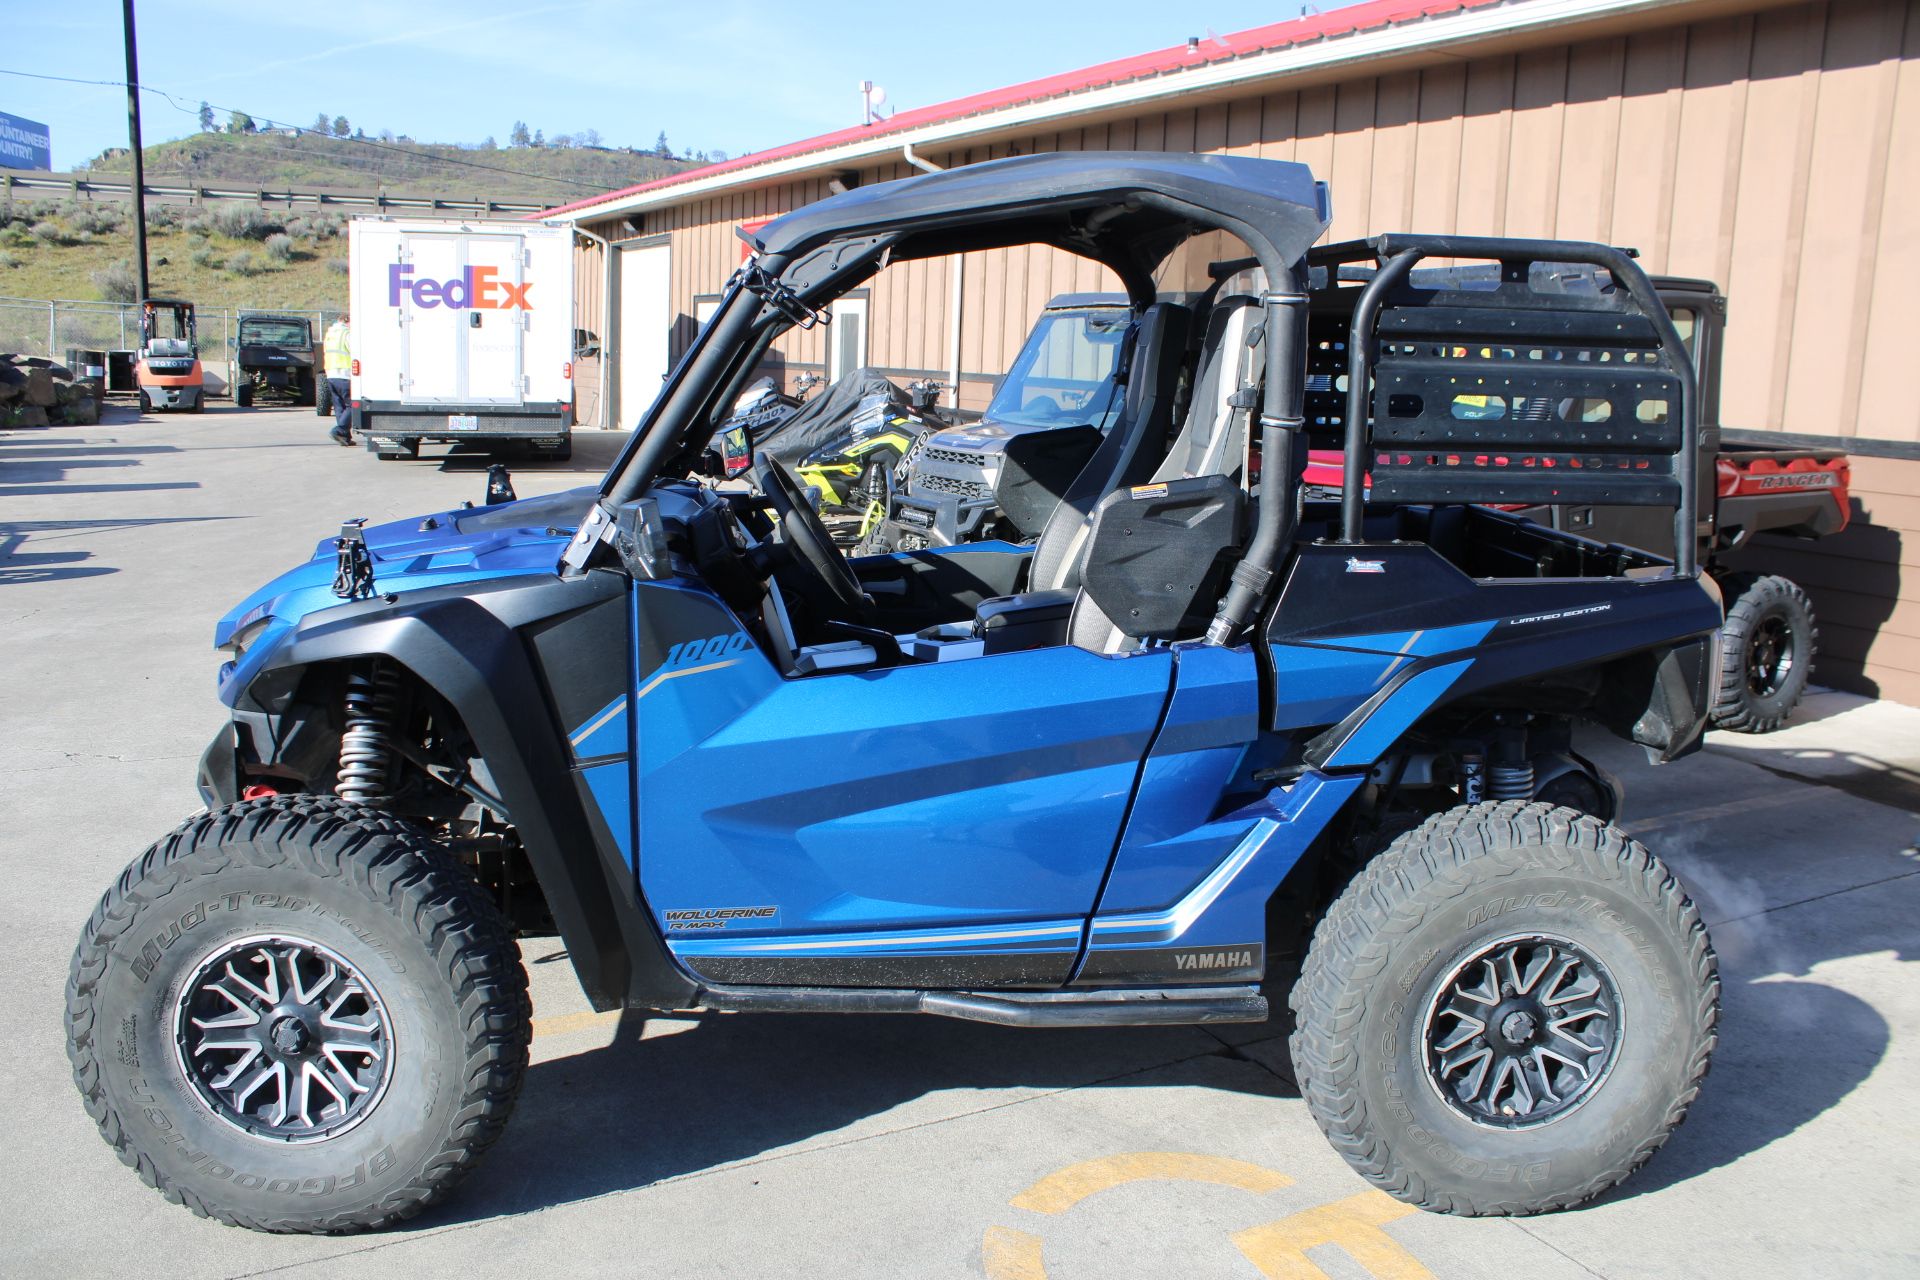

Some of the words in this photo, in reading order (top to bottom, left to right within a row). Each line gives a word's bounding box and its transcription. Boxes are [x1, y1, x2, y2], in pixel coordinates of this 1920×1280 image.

[388, 263, 534, 310] FedEx
[897, 429, 930, 481] PRO
[1760, 474, 1831, 489] RANGER
[1510, 612, 1561, 625] LIMITED
[1562, 604, 1611, 617] EDITION
[666, 631, 750, 664] 1000
[666, 907, 777, 921] WOLVERINE
[1175, 951, 1252, 970] YAMAHA
[1378, 1000, 1552, 1183] BFGoodrich
[128, 1078, 397, 1198] BFGoodrich
